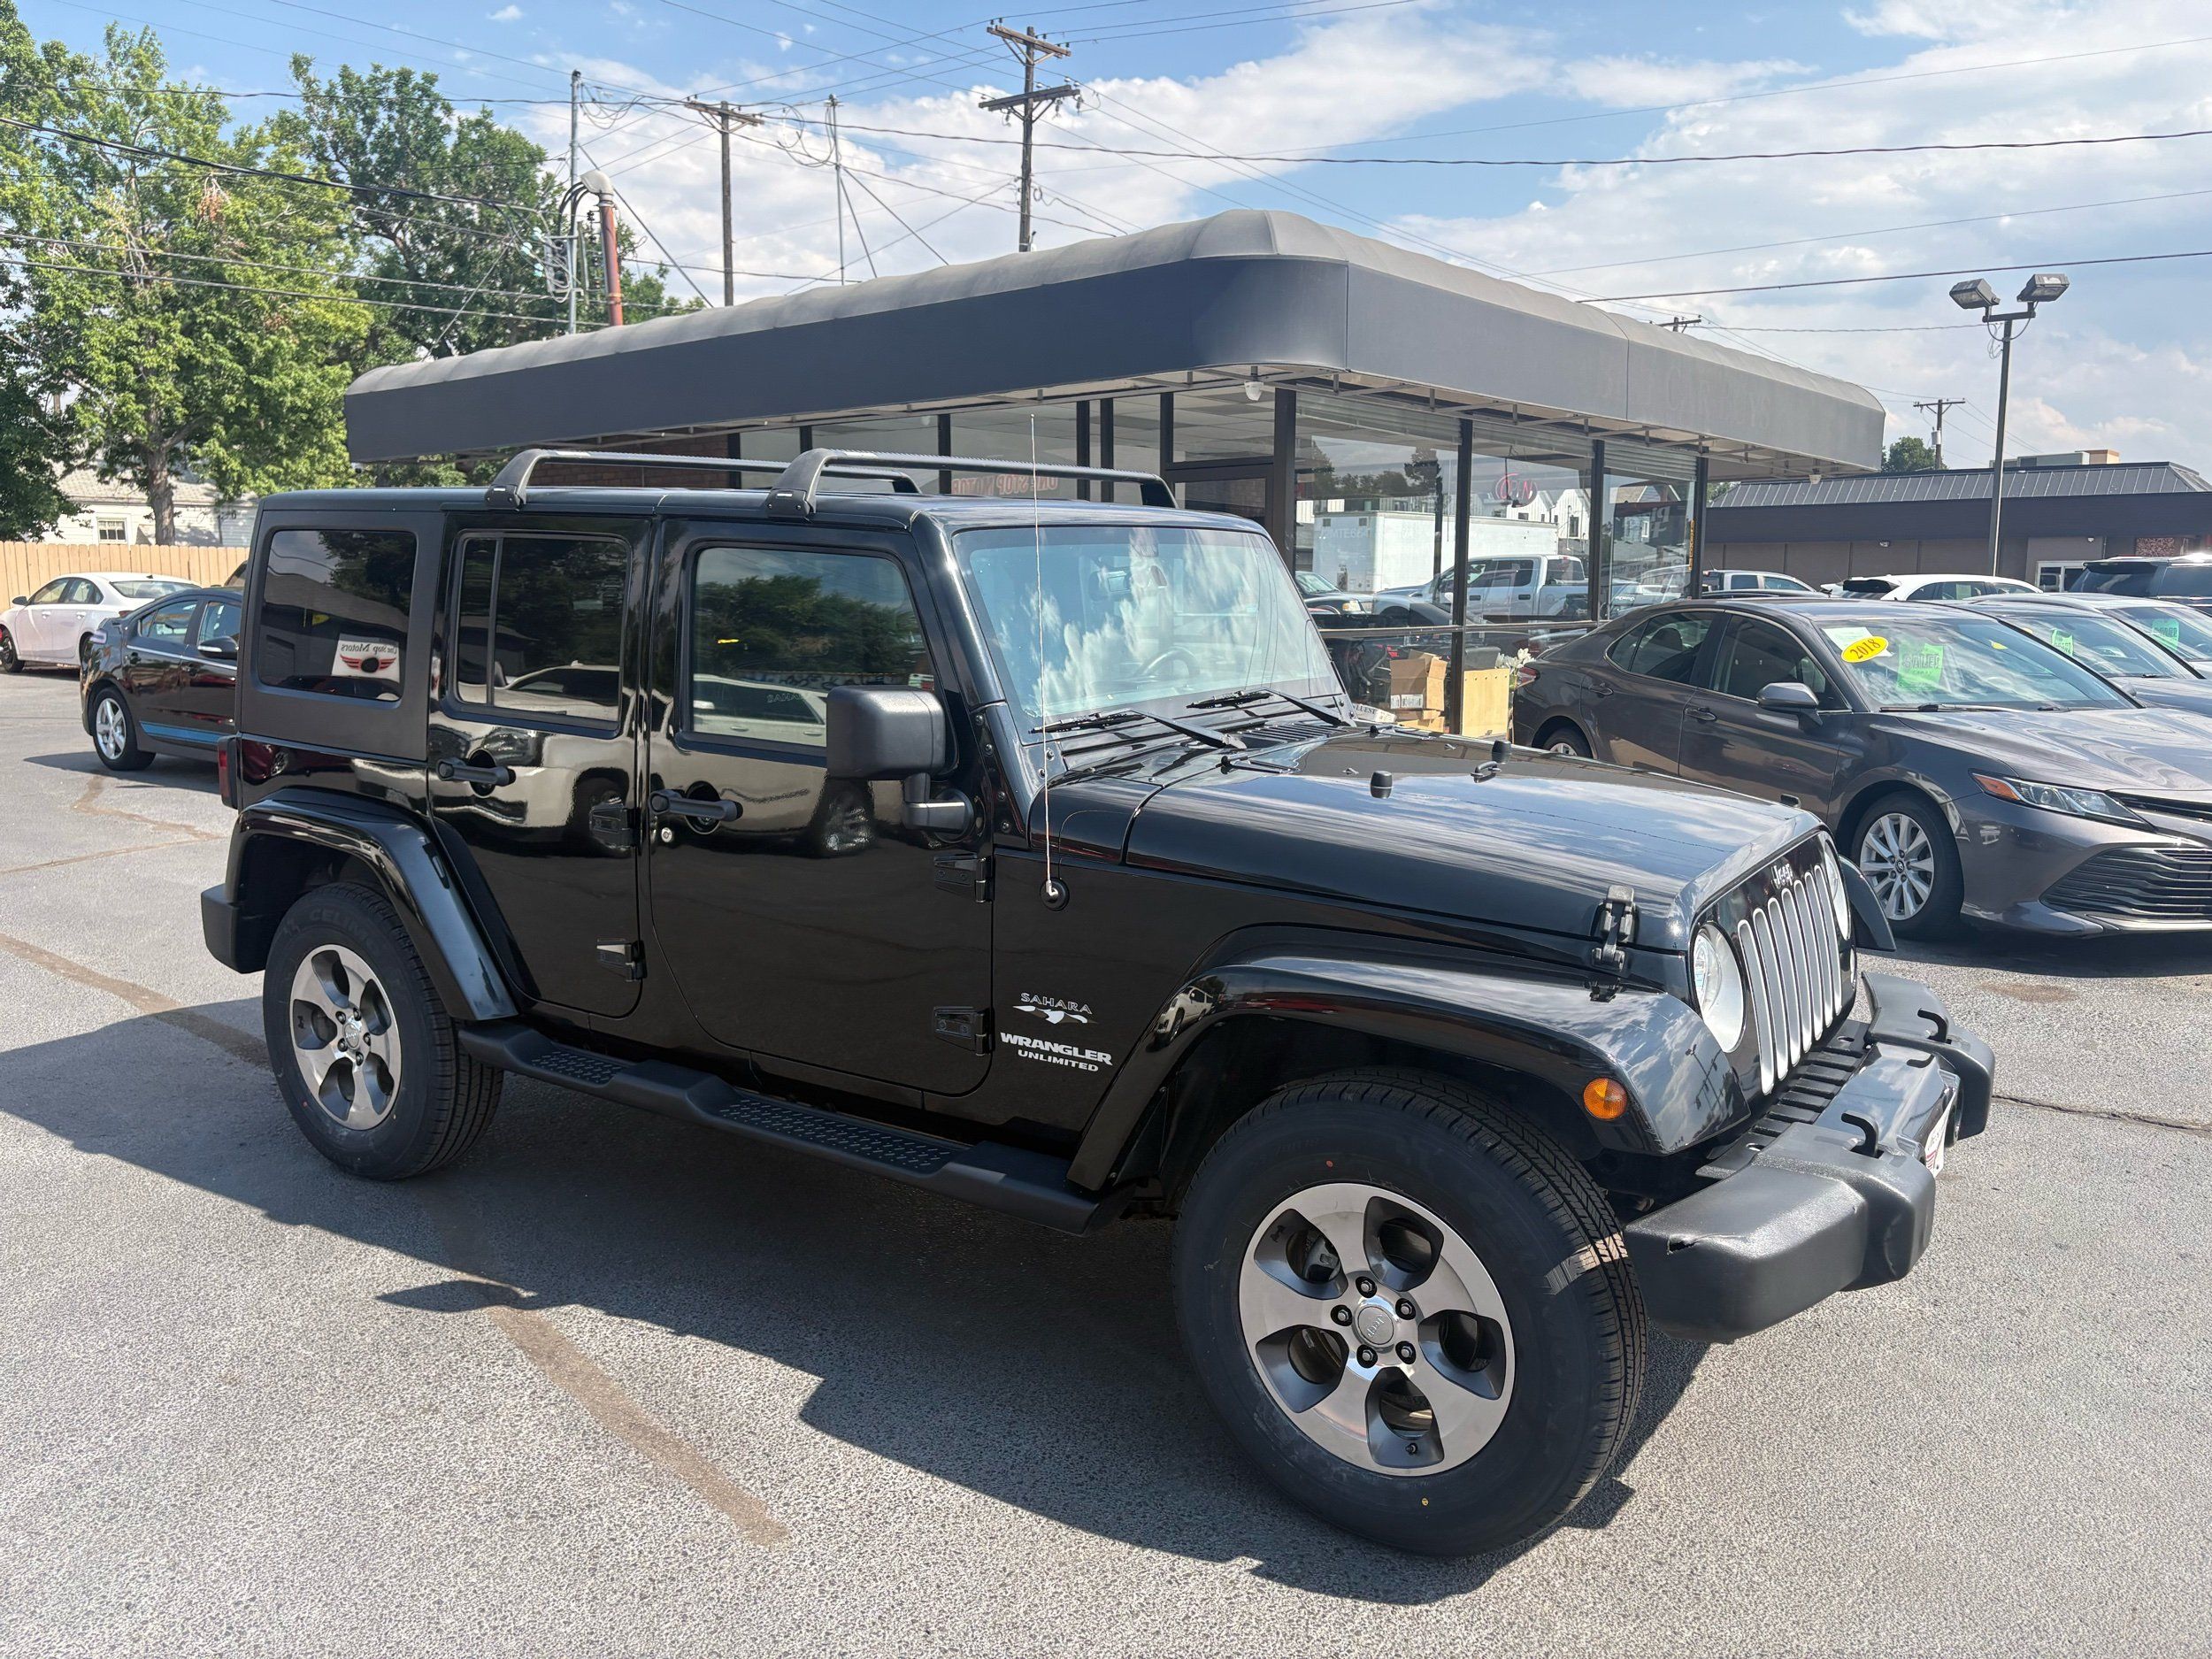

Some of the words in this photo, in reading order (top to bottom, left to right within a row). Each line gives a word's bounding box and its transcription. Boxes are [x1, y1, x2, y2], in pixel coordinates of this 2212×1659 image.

[1849, 638, 1881, 659] 2018
[1770, 863, 1794, 889] Jeep
[1020, 992, 1093, 1015] SAHARA
[1000, 1032, 1113, 1066] WRANGLER
[1018, 1049, 1099, 1072] UNLIMITED
[1366, 1315, 1385, 1338] Jeep
